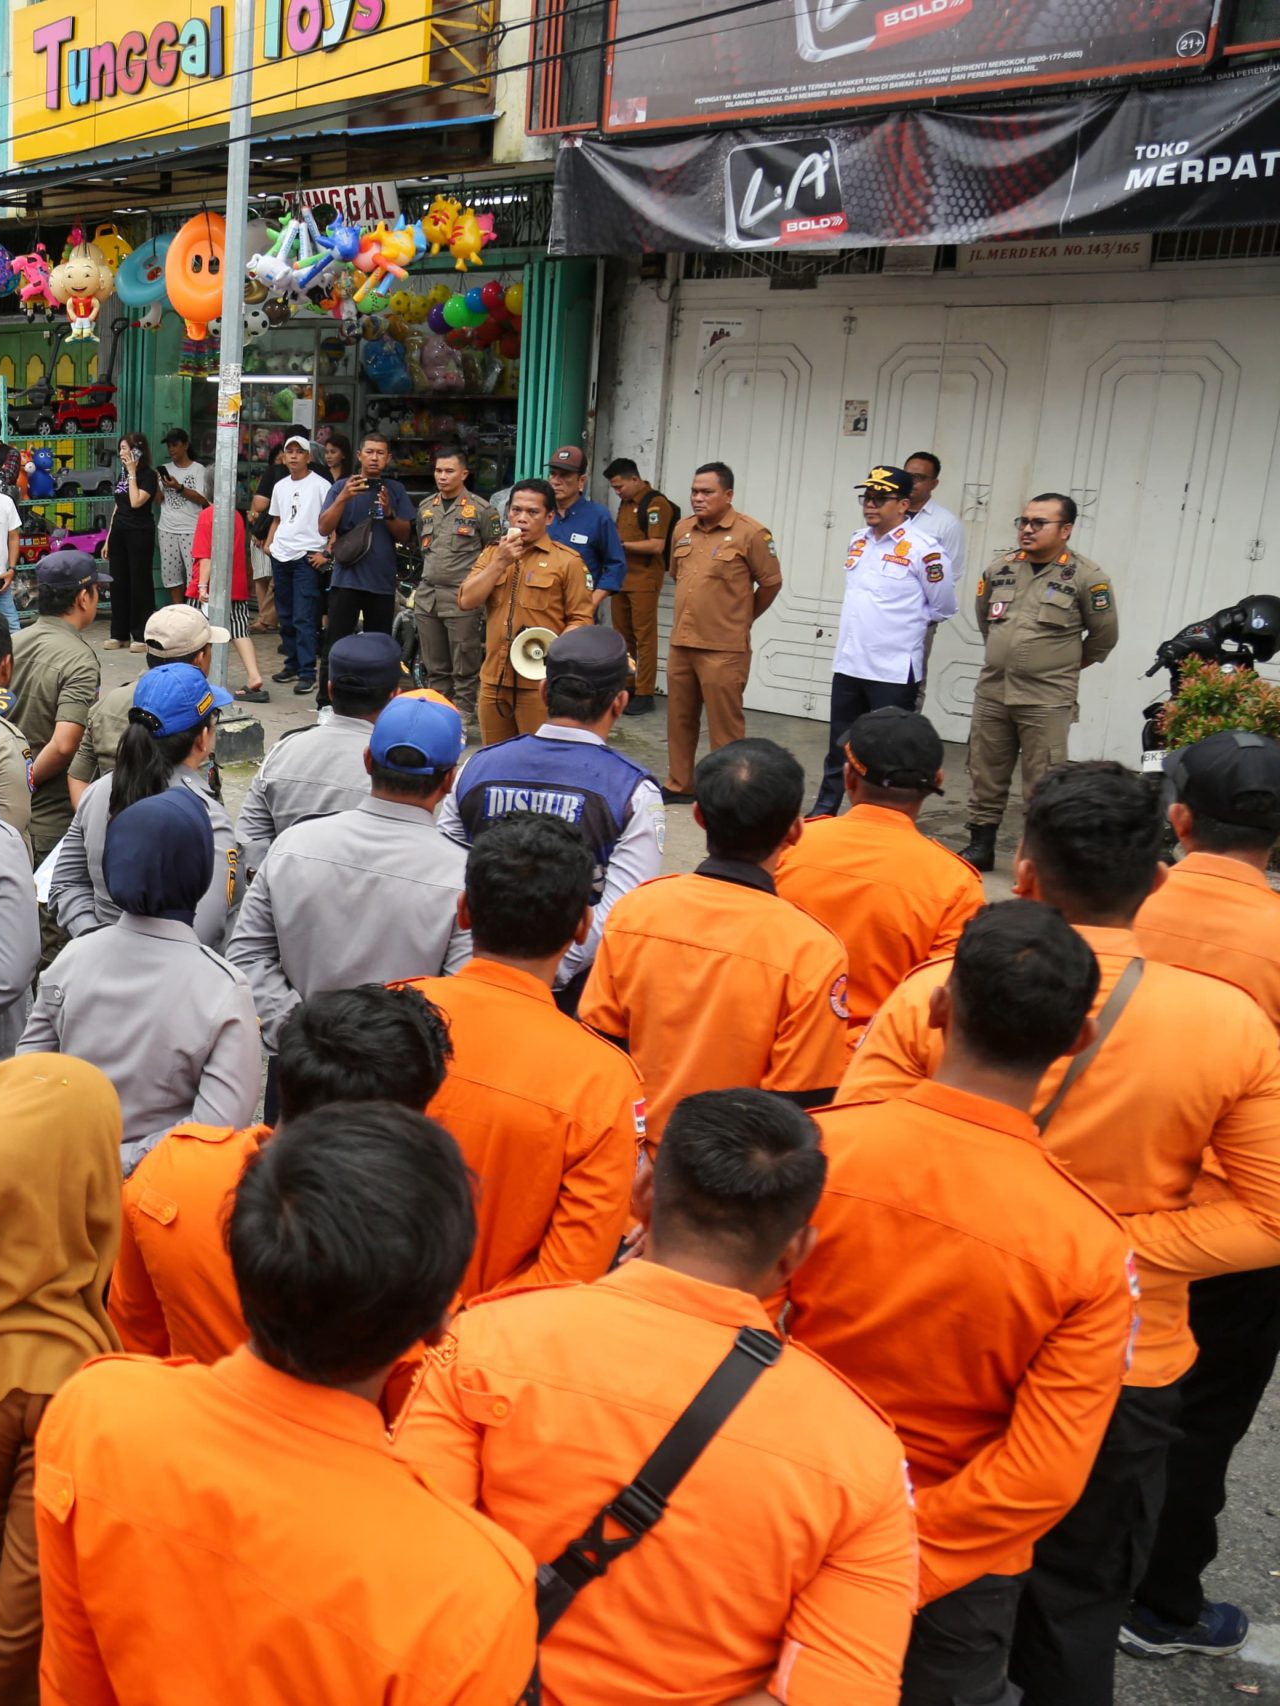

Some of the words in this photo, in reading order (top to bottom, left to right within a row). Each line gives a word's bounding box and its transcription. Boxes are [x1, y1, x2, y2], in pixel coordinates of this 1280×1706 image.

[883, 0, 948, 27] BOLD
[1179, 39, 1203, 51] 21+
[733, 91, 756, 100] KARENA
[757, 88, 790, 97] MEROKOK,
[791, 85, 807, 93] SAYA
[808, 82, 836, 91] TERKENA
[837, 78, 864, 87] KANKER
[865, 72, 917, 84] TENGGOROKAN.
[918, 67, 951, 77] LAYANAN
[951, 62, 987, 73] BERHENTI
[988, 58, 1026, 69] MEROKOK
[1216, 71, 1235, 80] DAN
[1236, 64, 1280, 77] PEREMPU
[725, 99, 754, 108] DILARANG
[755, 95, 783, 104] MENJUAL
[784, 93, 798, 101] DAN
[798, 91, 828, 99] MEMBERI
[829, 87, 856, 96] KEPADA
[856, 84, 880, 93] ORANG
[889, 80, 914, 89] BAWAH
[915, 78, 923, 86] 21
[924, 76, 948, 85] TAHUN
[950, 73, 966, 81] DAN
[967, 68, 1012, 79] PEREMPUAN
[1134, 141, 1190, 160] TOKO
[1124, 151, 1280, 190] MERPAT
[786, 218, 832, 232] BOLD
[488, 788, 579, 823] DISHUB
